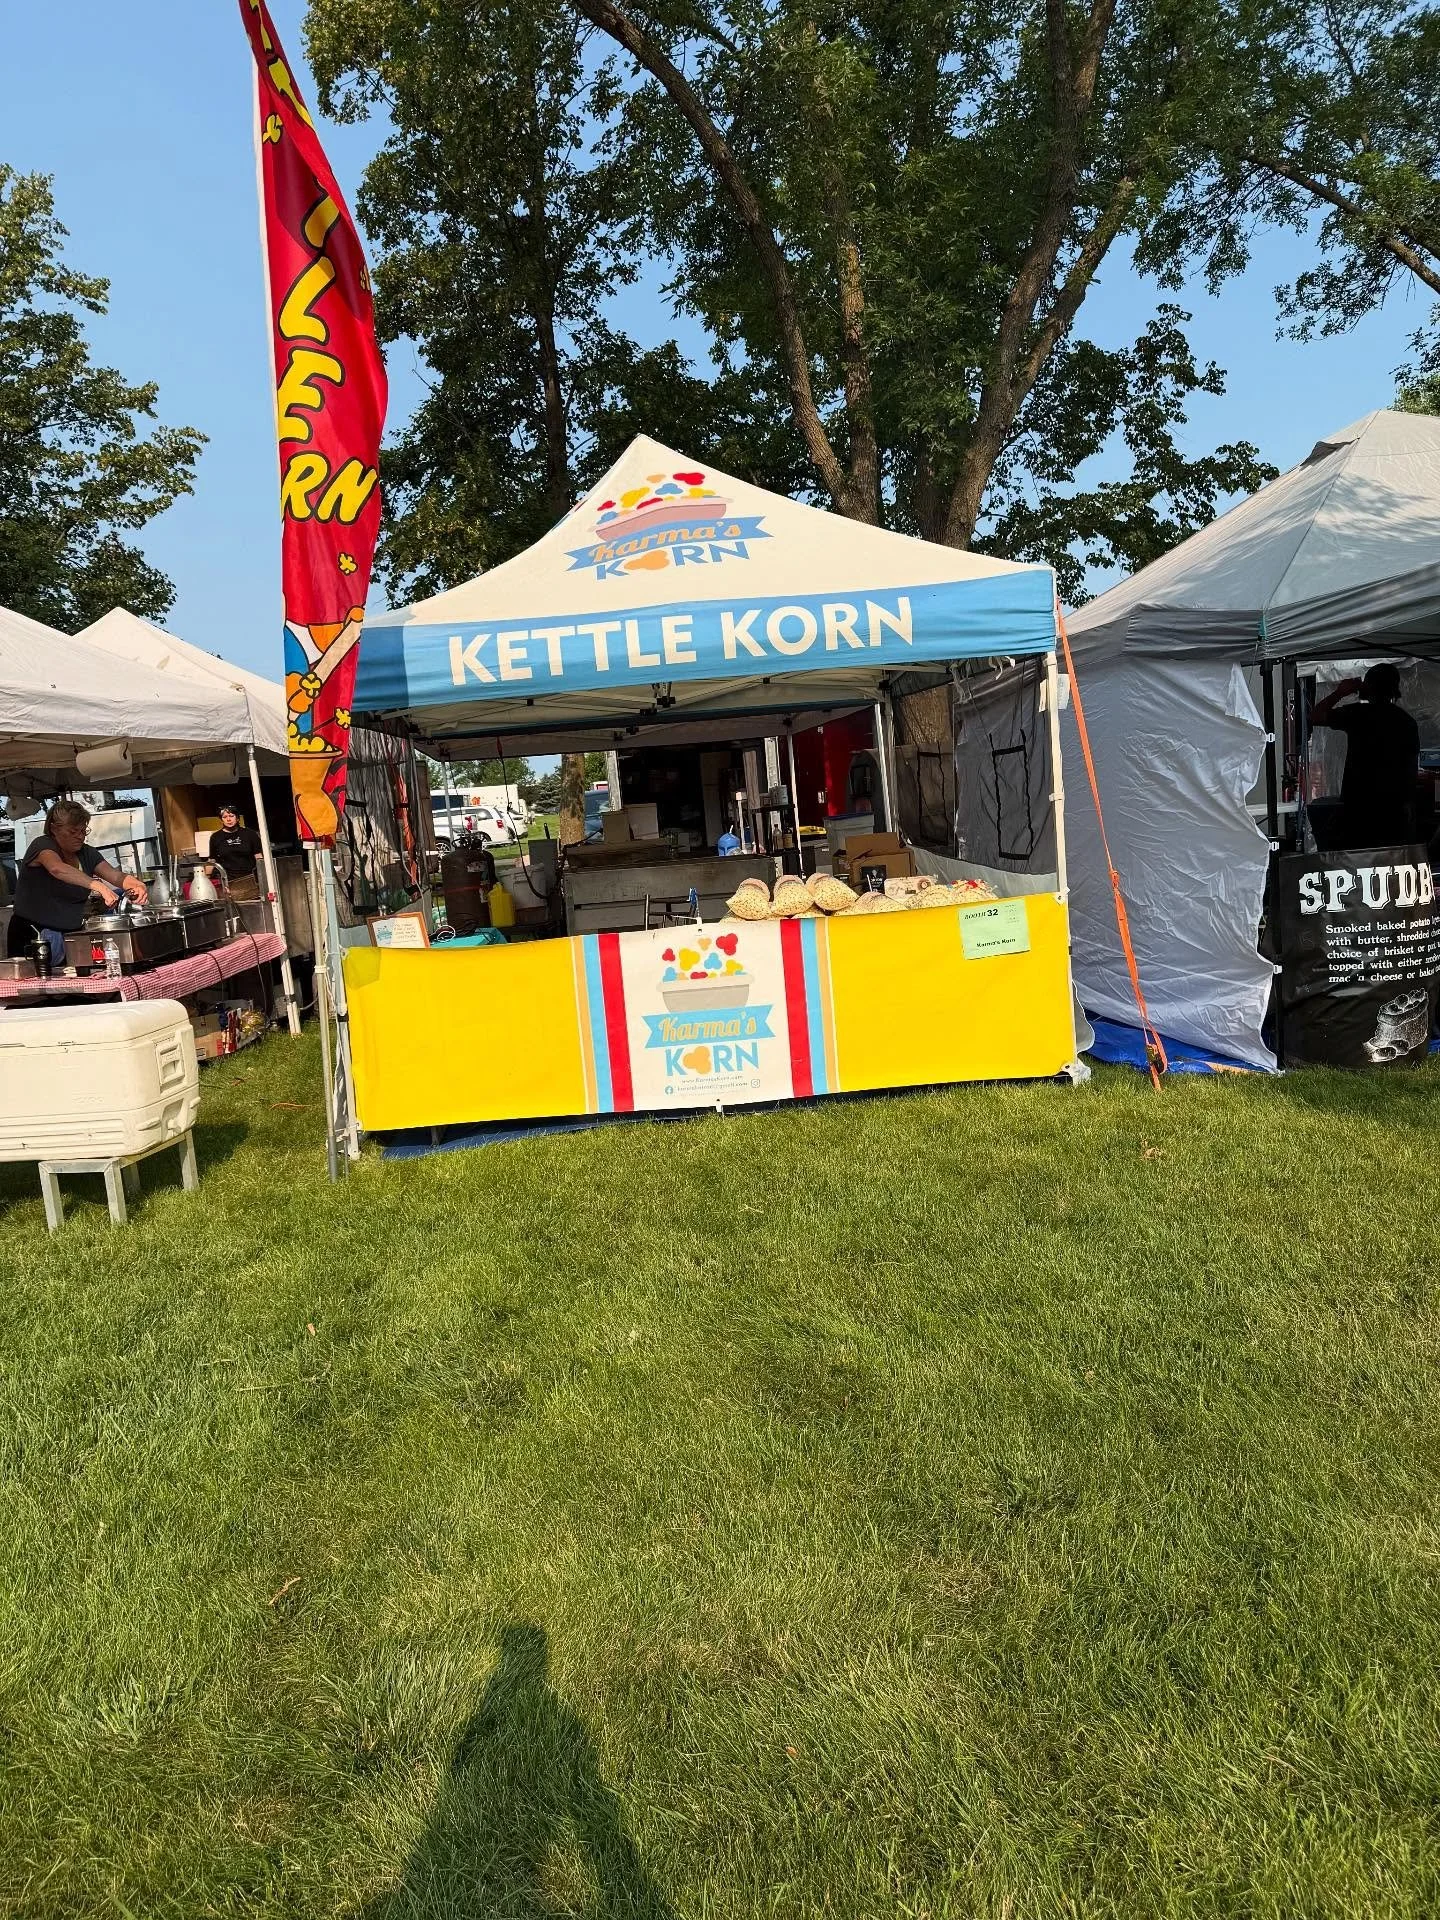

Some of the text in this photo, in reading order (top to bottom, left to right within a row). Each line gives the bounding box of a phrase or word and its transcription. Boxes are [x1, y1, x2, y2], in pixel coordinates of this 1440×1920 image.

[588, 521, 742, 563] Karma's
[448, 596, 914, 686] KETTLE KORN
[987, 908, 999, 917] 32
[1325, 922, 1372, 934] Smoked
[1376, 920, 1406, 931] baked
[1409, 918, 1431, 929] potato
[1326, 936, 1352, 946] with
[1357, 935, 1393, 945] butter,
[1396, 930, 1430, 942] shredded
[1326, 949, 1362, 960] choice
[1367, 947, 1379, 957] of
[1384, 945, 1415, 956] brisket
[1417, 945, 1426, 953] or
[1328, 961, 1365, 972] topped
[1369, 960, 1393, 970] with
[1397, 957, 1423, 968] either
[1328, 974, 1351, 983] mac
[1356, 973, 1365, 982] 'n
[1370, 972, 1403, 982] cheese
[1406, 971, 1416, 979] or
[659, 1011, 757, 1042] Karma's
